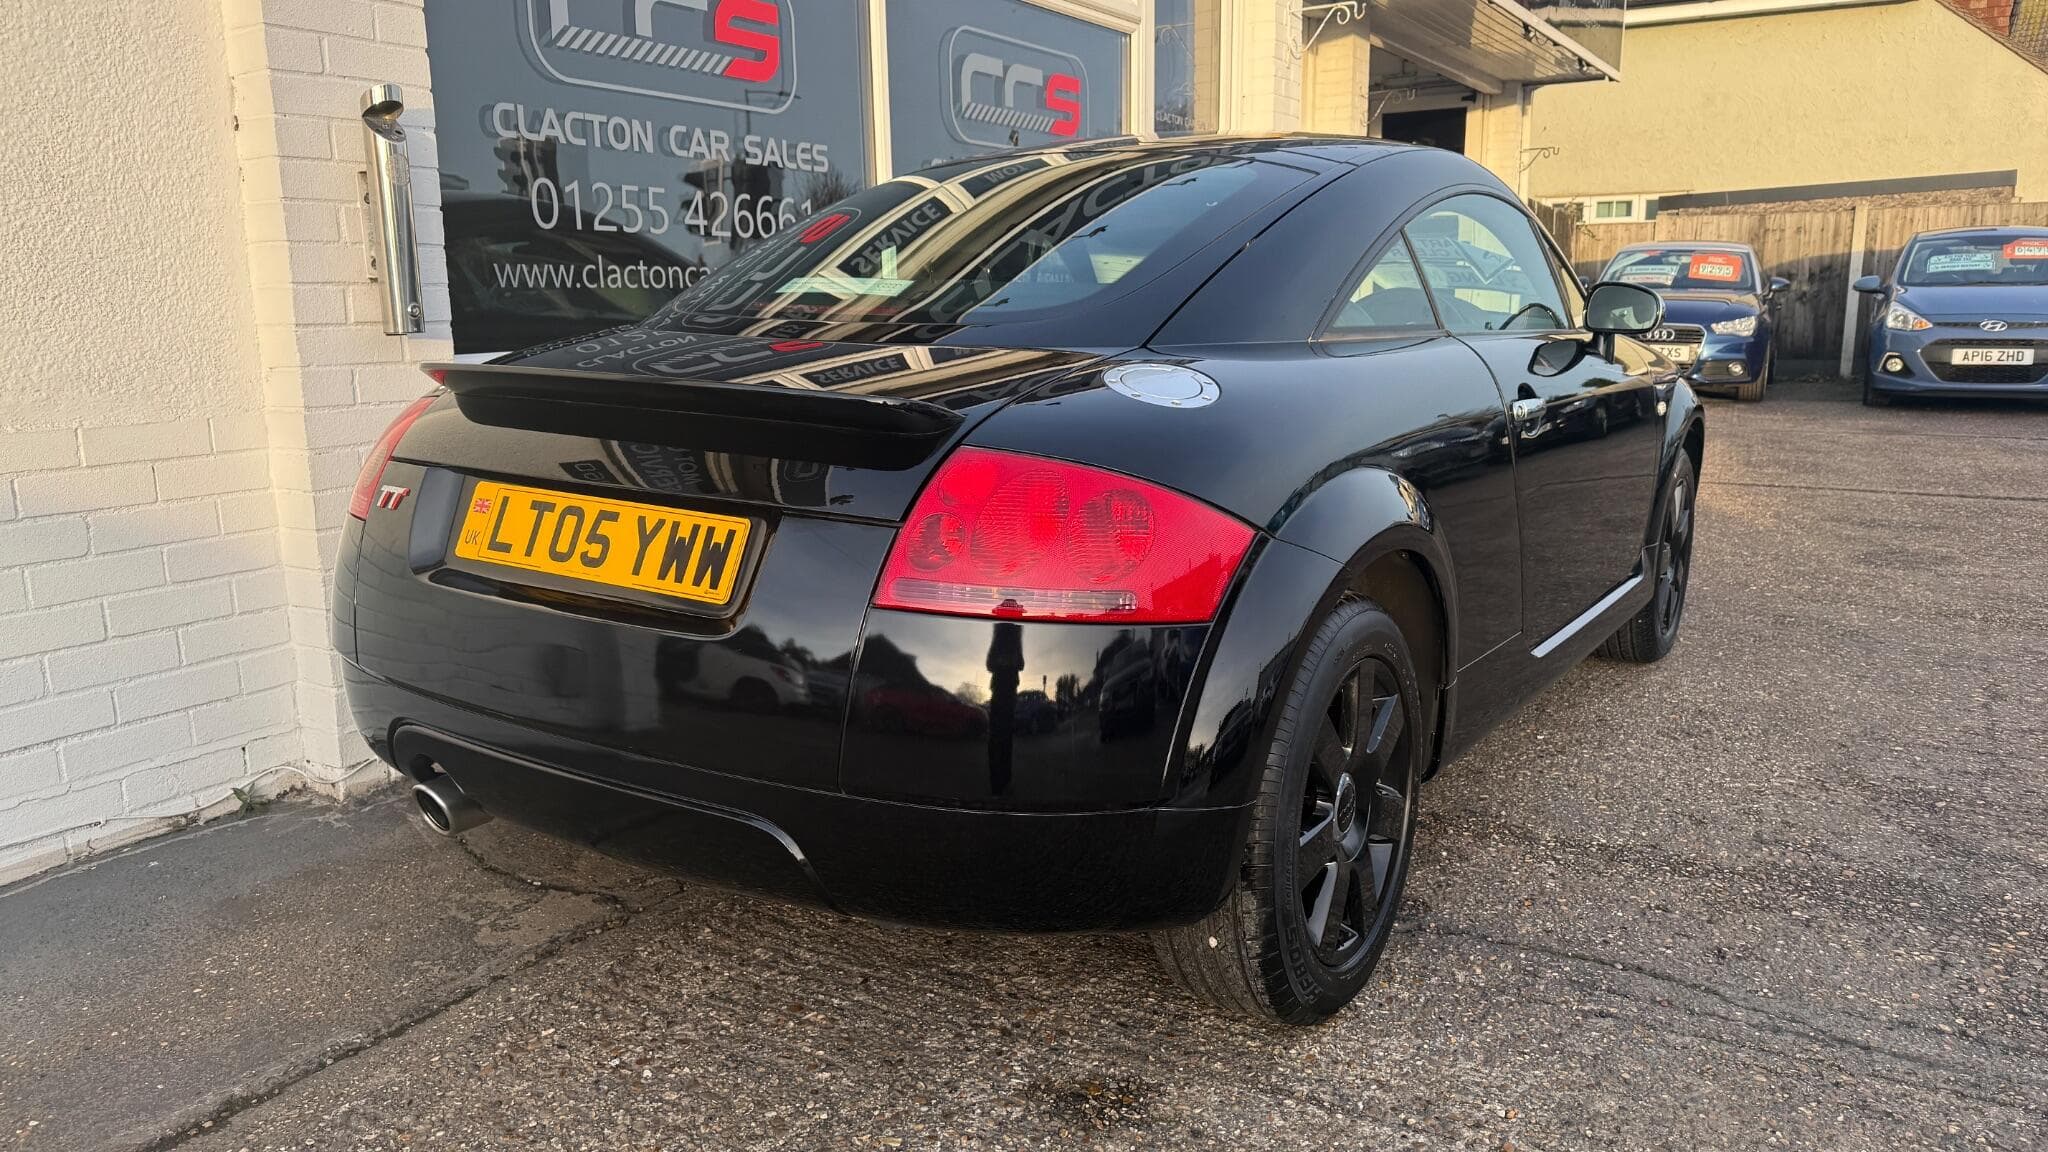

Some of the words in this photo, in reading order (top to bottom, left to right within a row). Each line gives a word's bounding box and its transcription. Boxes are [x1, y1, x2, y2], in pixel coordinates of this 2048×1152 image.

[492, 102, 654, 153] CLACTON
[668, 125, 730, 162] CAR
[743, 135, 829, 173] SALES
[531, 177, 669, 234] 01255
[494, 255, 718, 289] www.clactonc
[1962, 351, 1993, 362] AP16
[1997, 350, 2025, 362] ZHD
[464, 529, 481, 545] UK
[486, 496, 620, 570] LT05
[631, 517, 736, 590] YWW
